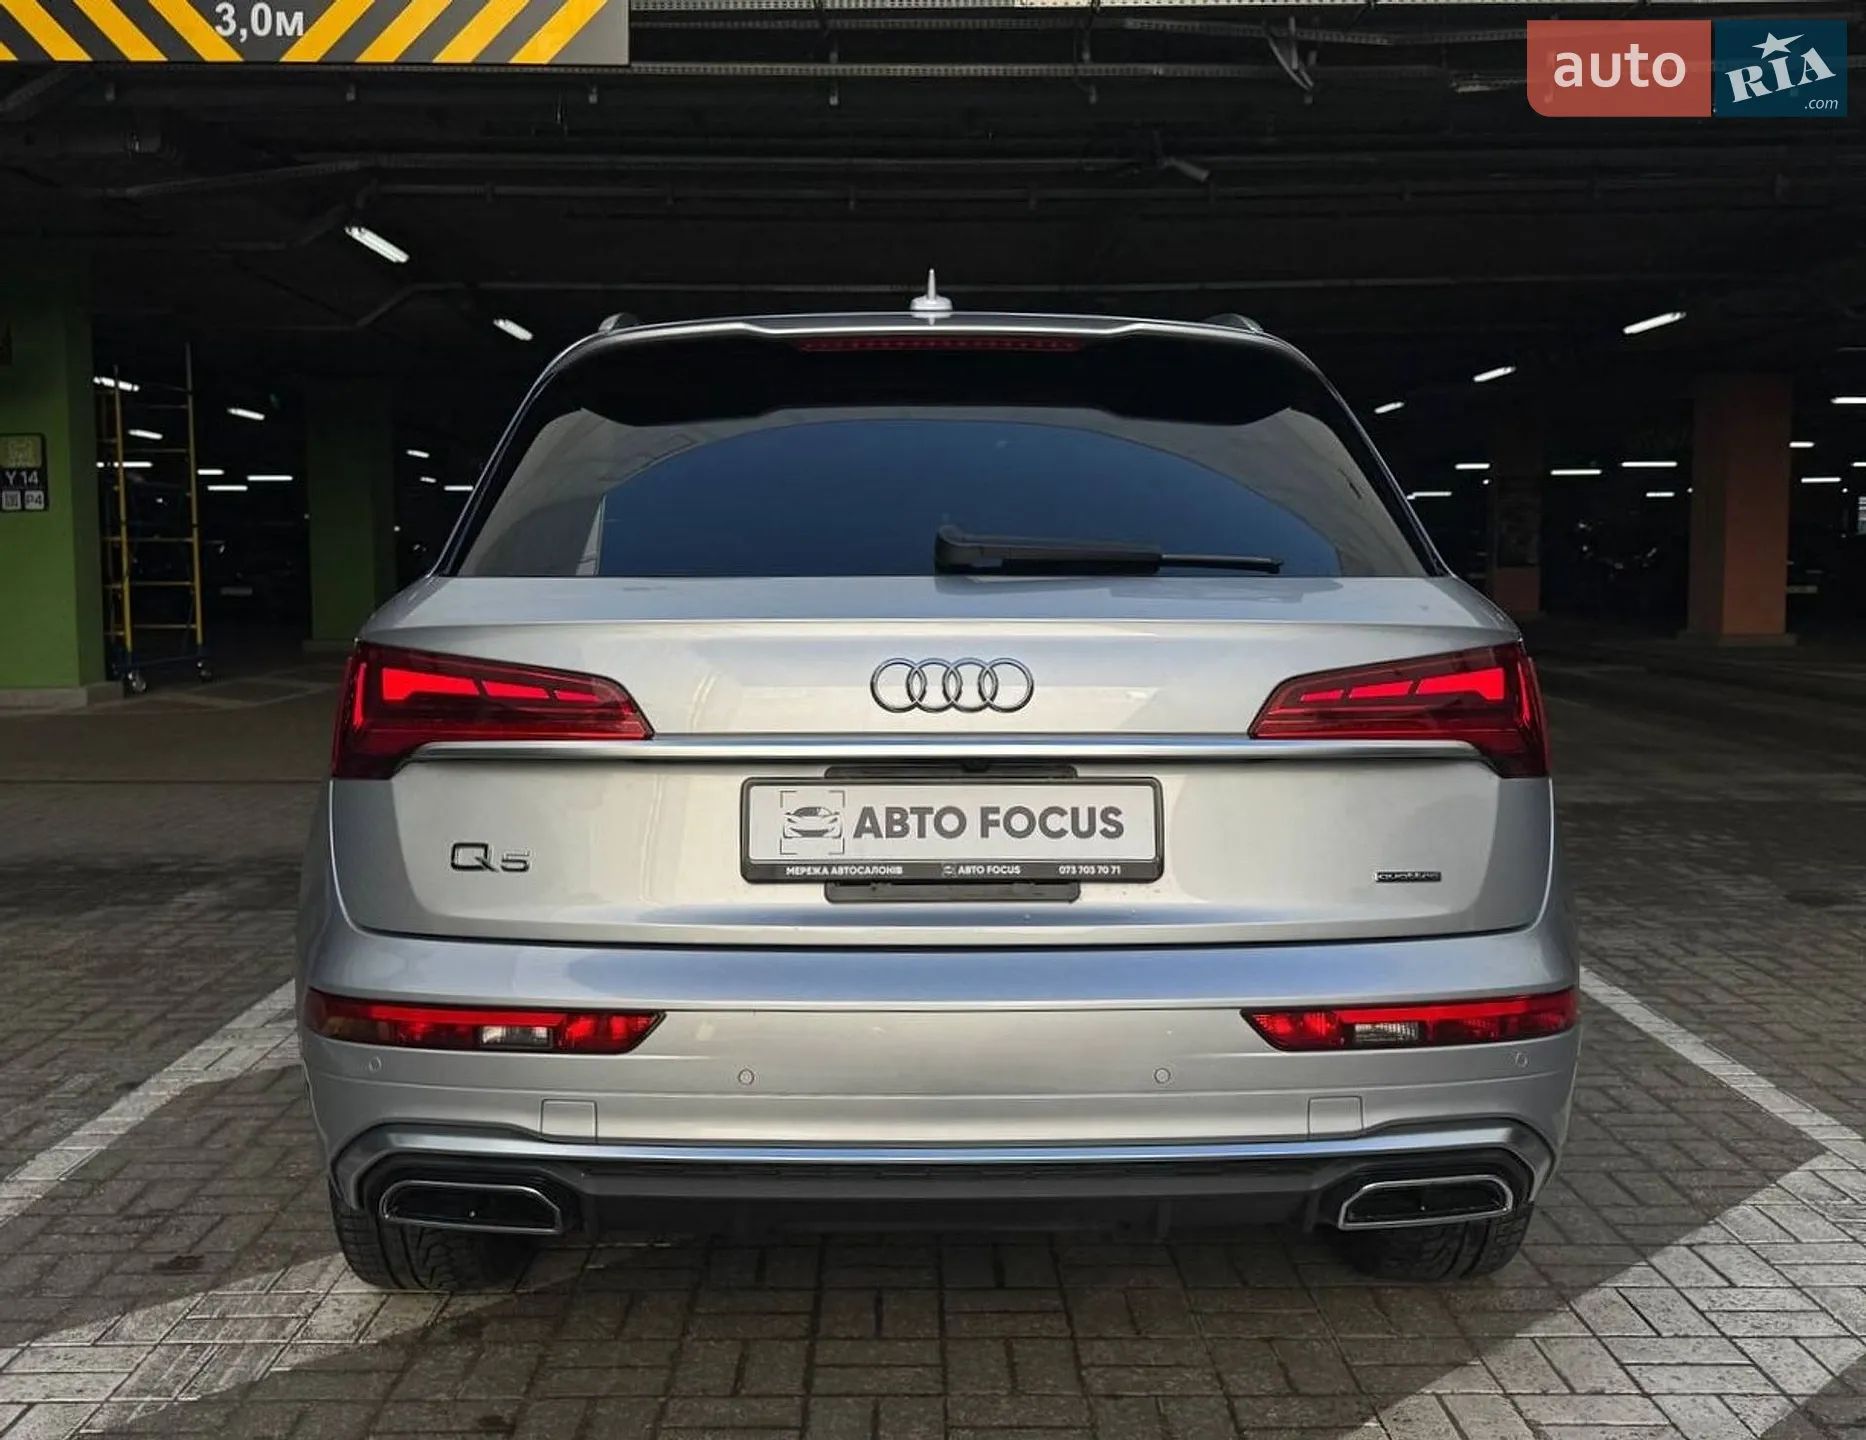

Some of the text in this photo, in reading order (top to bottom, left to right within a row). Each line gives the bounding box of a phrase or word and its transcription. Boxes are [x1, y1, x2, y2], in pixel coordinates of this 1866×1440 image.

[20, 470, 39, 485] 14
[853, 805, 1124, 839] АВТО FOCUS
[450, 842, 530, 873] Q5
[785, 866, 903, 876] МЕРЕЖА АВТОСАЛОНІВ
[957, 865, 1021, 875] АВТО FOCUS
[1058, 865, 1121, 875] 073 703 70 71
